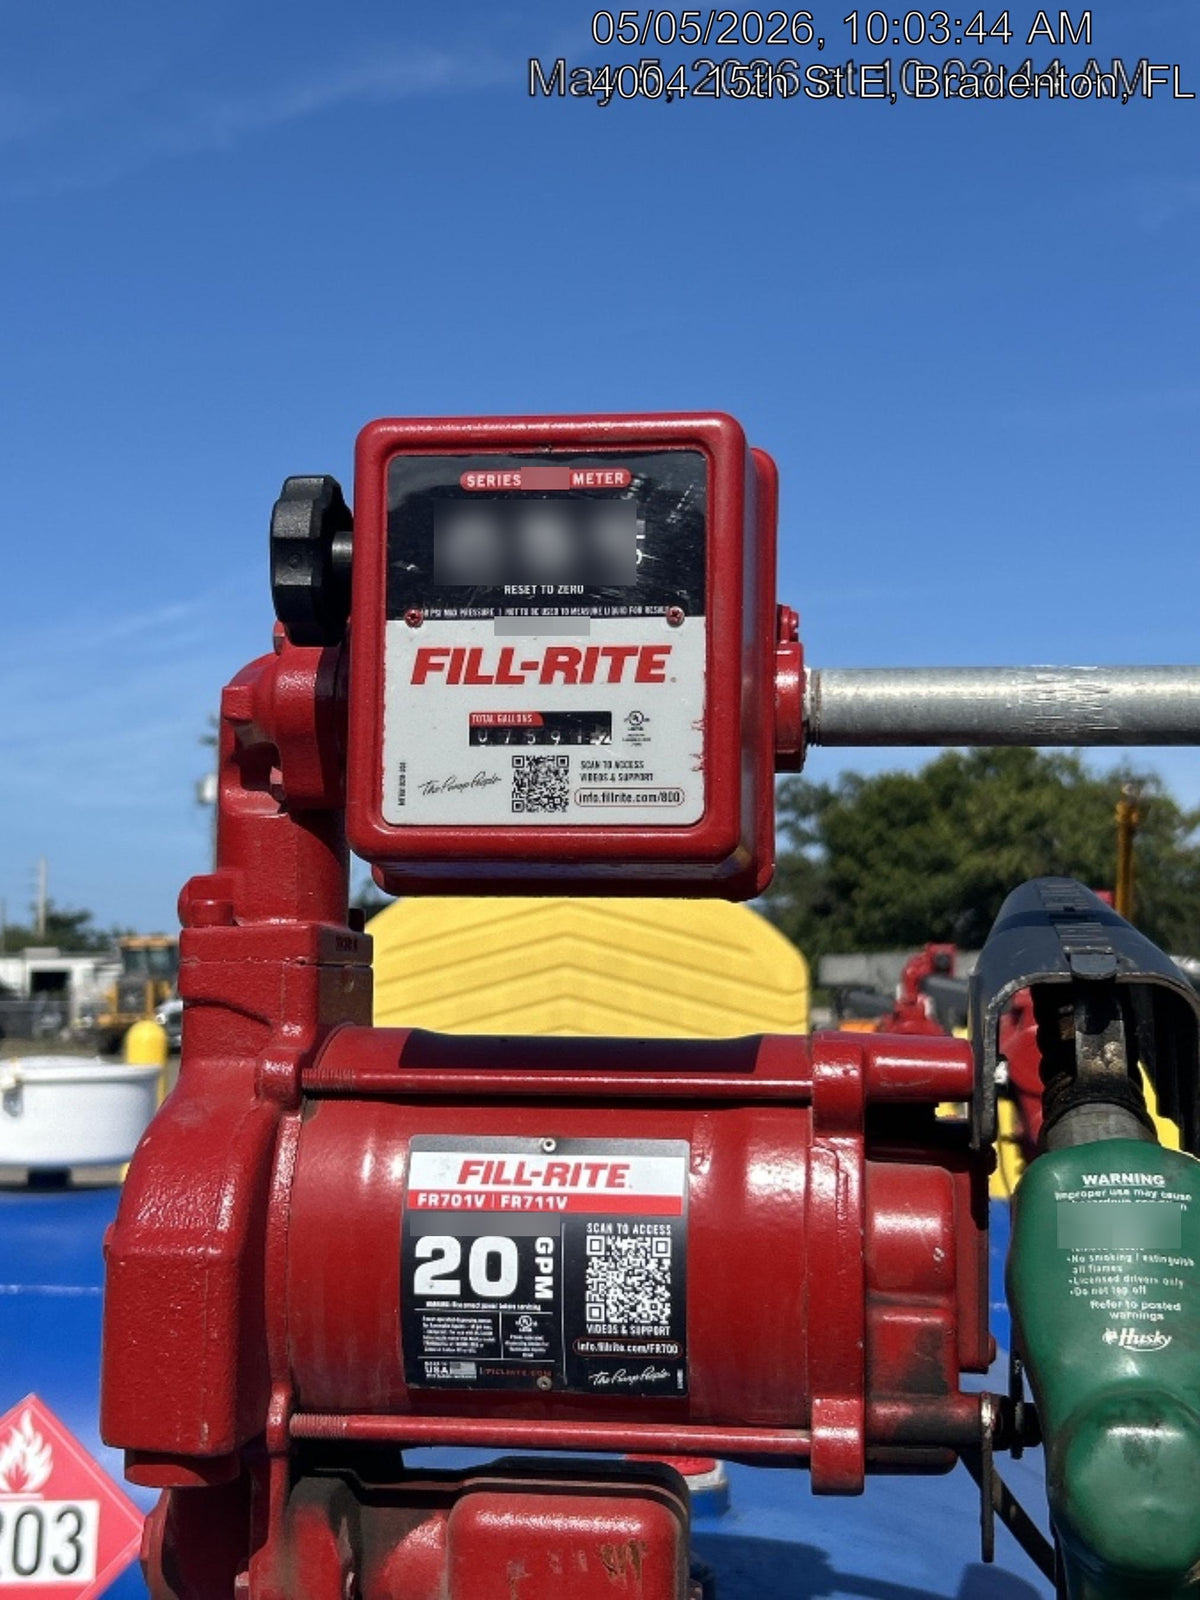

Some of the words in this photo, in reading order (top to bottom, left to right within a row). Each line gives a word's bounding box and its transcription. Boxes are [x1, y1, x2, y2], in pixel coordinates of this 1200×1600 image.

[467, 474, 522, 488] SERIES
[572, 472, 625, 486] METER
[504, 585, 537, 595] RESET
[540, 585, 554, 595] TO
[557, 585, 584, 595] ZERO
[410, 645, 672, 685] FILL-RITE
[471, 714, 494, 722] TOTAL
[497, 714, 533, 722] GALLONS
[457, 1160, 630, 1188] FILL-RITE
[1081, 1172, 1166, 1186] WARNING
[417, 1192, 486, 1208] FR701V
[500, 1193, 568, 1210] FR711V
[1054, 1188, 1107, 1201] Improper
[1109, 1188, 1130, 1196] use
[1134, 1188, 1158, 1199] may
[1160, 1191, 1192, 1201] cause
[586, 1222, 613, 1234] SCAN
[616, 1222, 629, 1235] TO
[632, 1223, 672, 1236] ACCESS
[414, 1235, 518, 1298] 20
[1071, 1254, 1086, 1263] No
[1089, 1252, 1132, 1264] smoking
[1142, 1254, 1195, 1267] extinguish
[535, 1236, 554, 1299] GPM
[1072, 1264, 1086, 1275] all
[1088, 1264, 1123, 1273] flames
[1073, 1274, 1120, 1286] Licensed
[1123, 1274, 1159, 1285] drivers
[1162, 1277, 1184, 1290] only
[1073, 1286, 1089, 1297] Do
[1091, 1286, 1109, 1296] not
[1111, 1286, 1129, 1297] top
[1132, 1285, 1147, 1295] off
[1089, 1299, 1121, 1310] Refer
[1124, 1299, 1139, 1310] to
[1141, 1300, 1182, 1312] posted
[1109, 1311, 1165, 1322] warnings
[586, 1324, 618, 1335] VIDEOS
[621, 1324, 628, 1335] &
[629, 1325, 671, 1336] SUPPORT
[1118, 1327, 1172, 1347] Husky
[0, 1505, 84, 1577] 03
